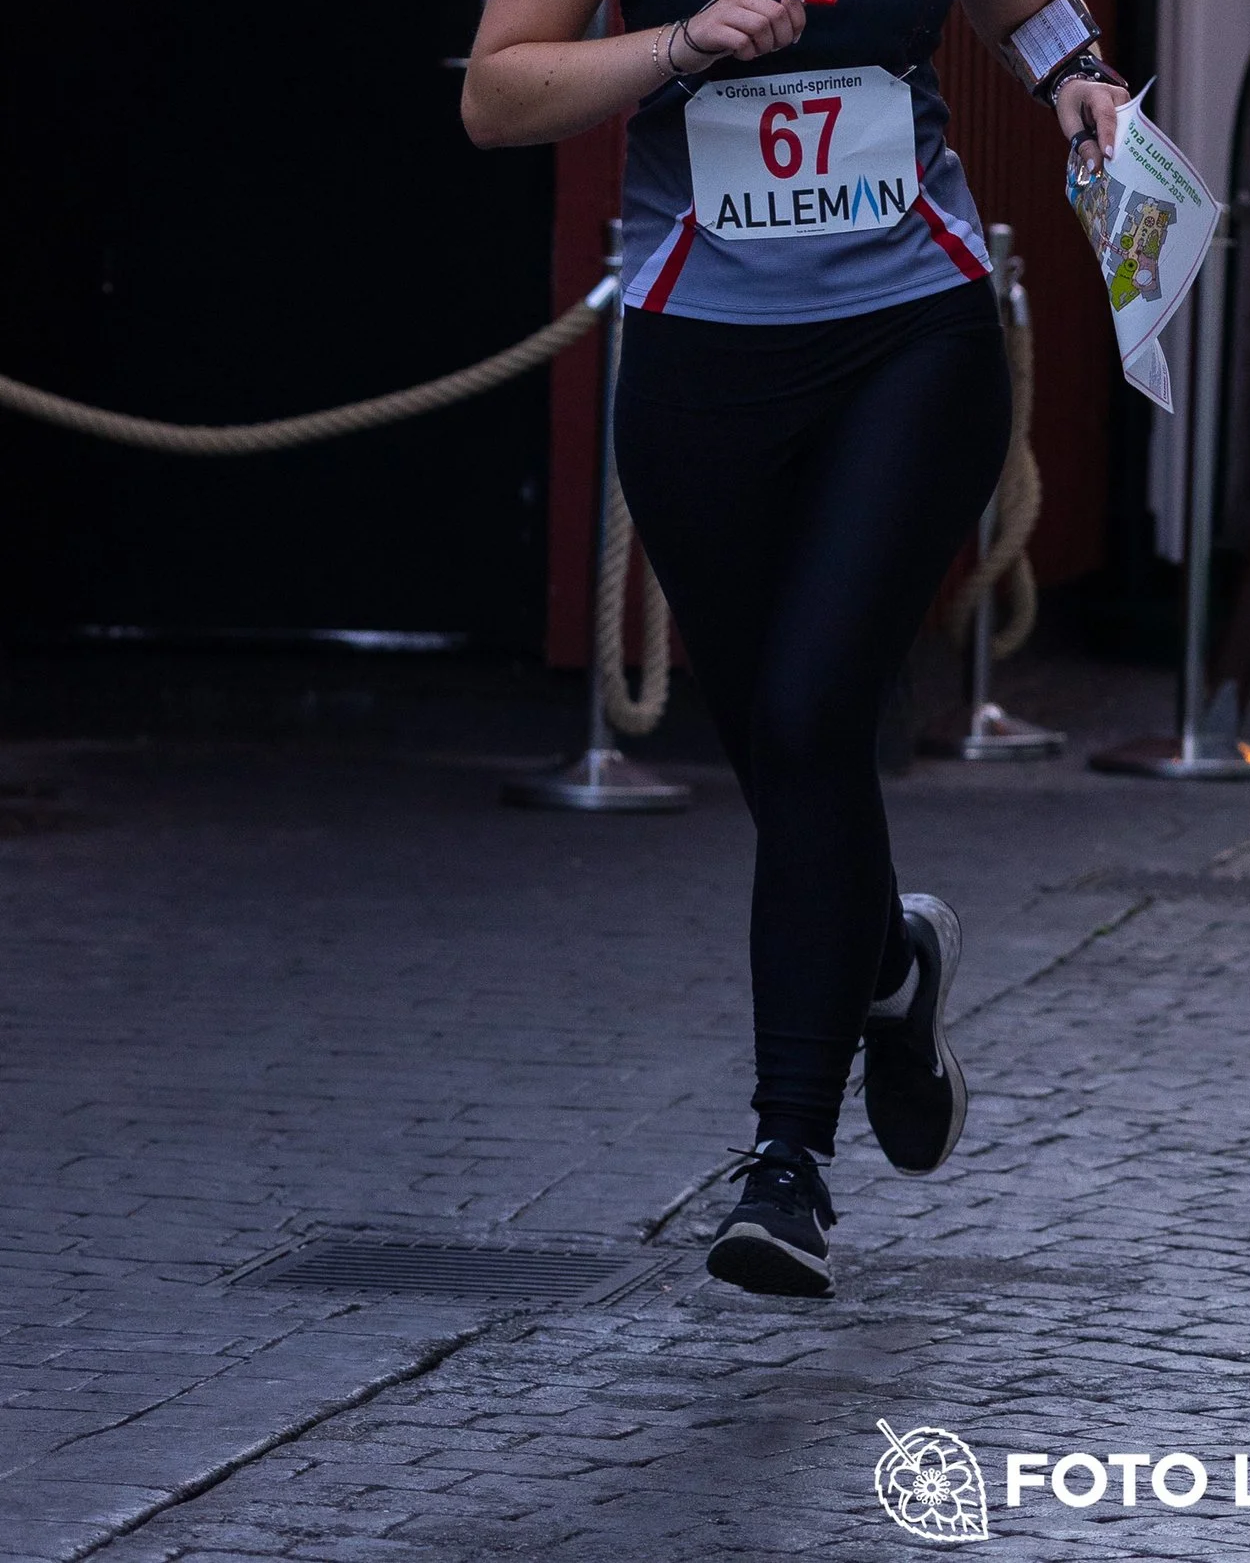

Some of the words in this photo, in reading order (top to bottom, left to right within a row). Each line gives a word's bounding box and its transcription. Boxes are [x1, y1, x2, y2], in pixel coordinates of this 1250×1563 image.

[725, 84, 766, 99] Gröna
[770, 76, 862, 95] Lund-sprinten
[758, 96, 843, 180] 67
[1129, 146, 1170, 189] september
[1169, 184, 1187, 205] 2025
[1145, 142, 1203, 208] Lund-sprinten
